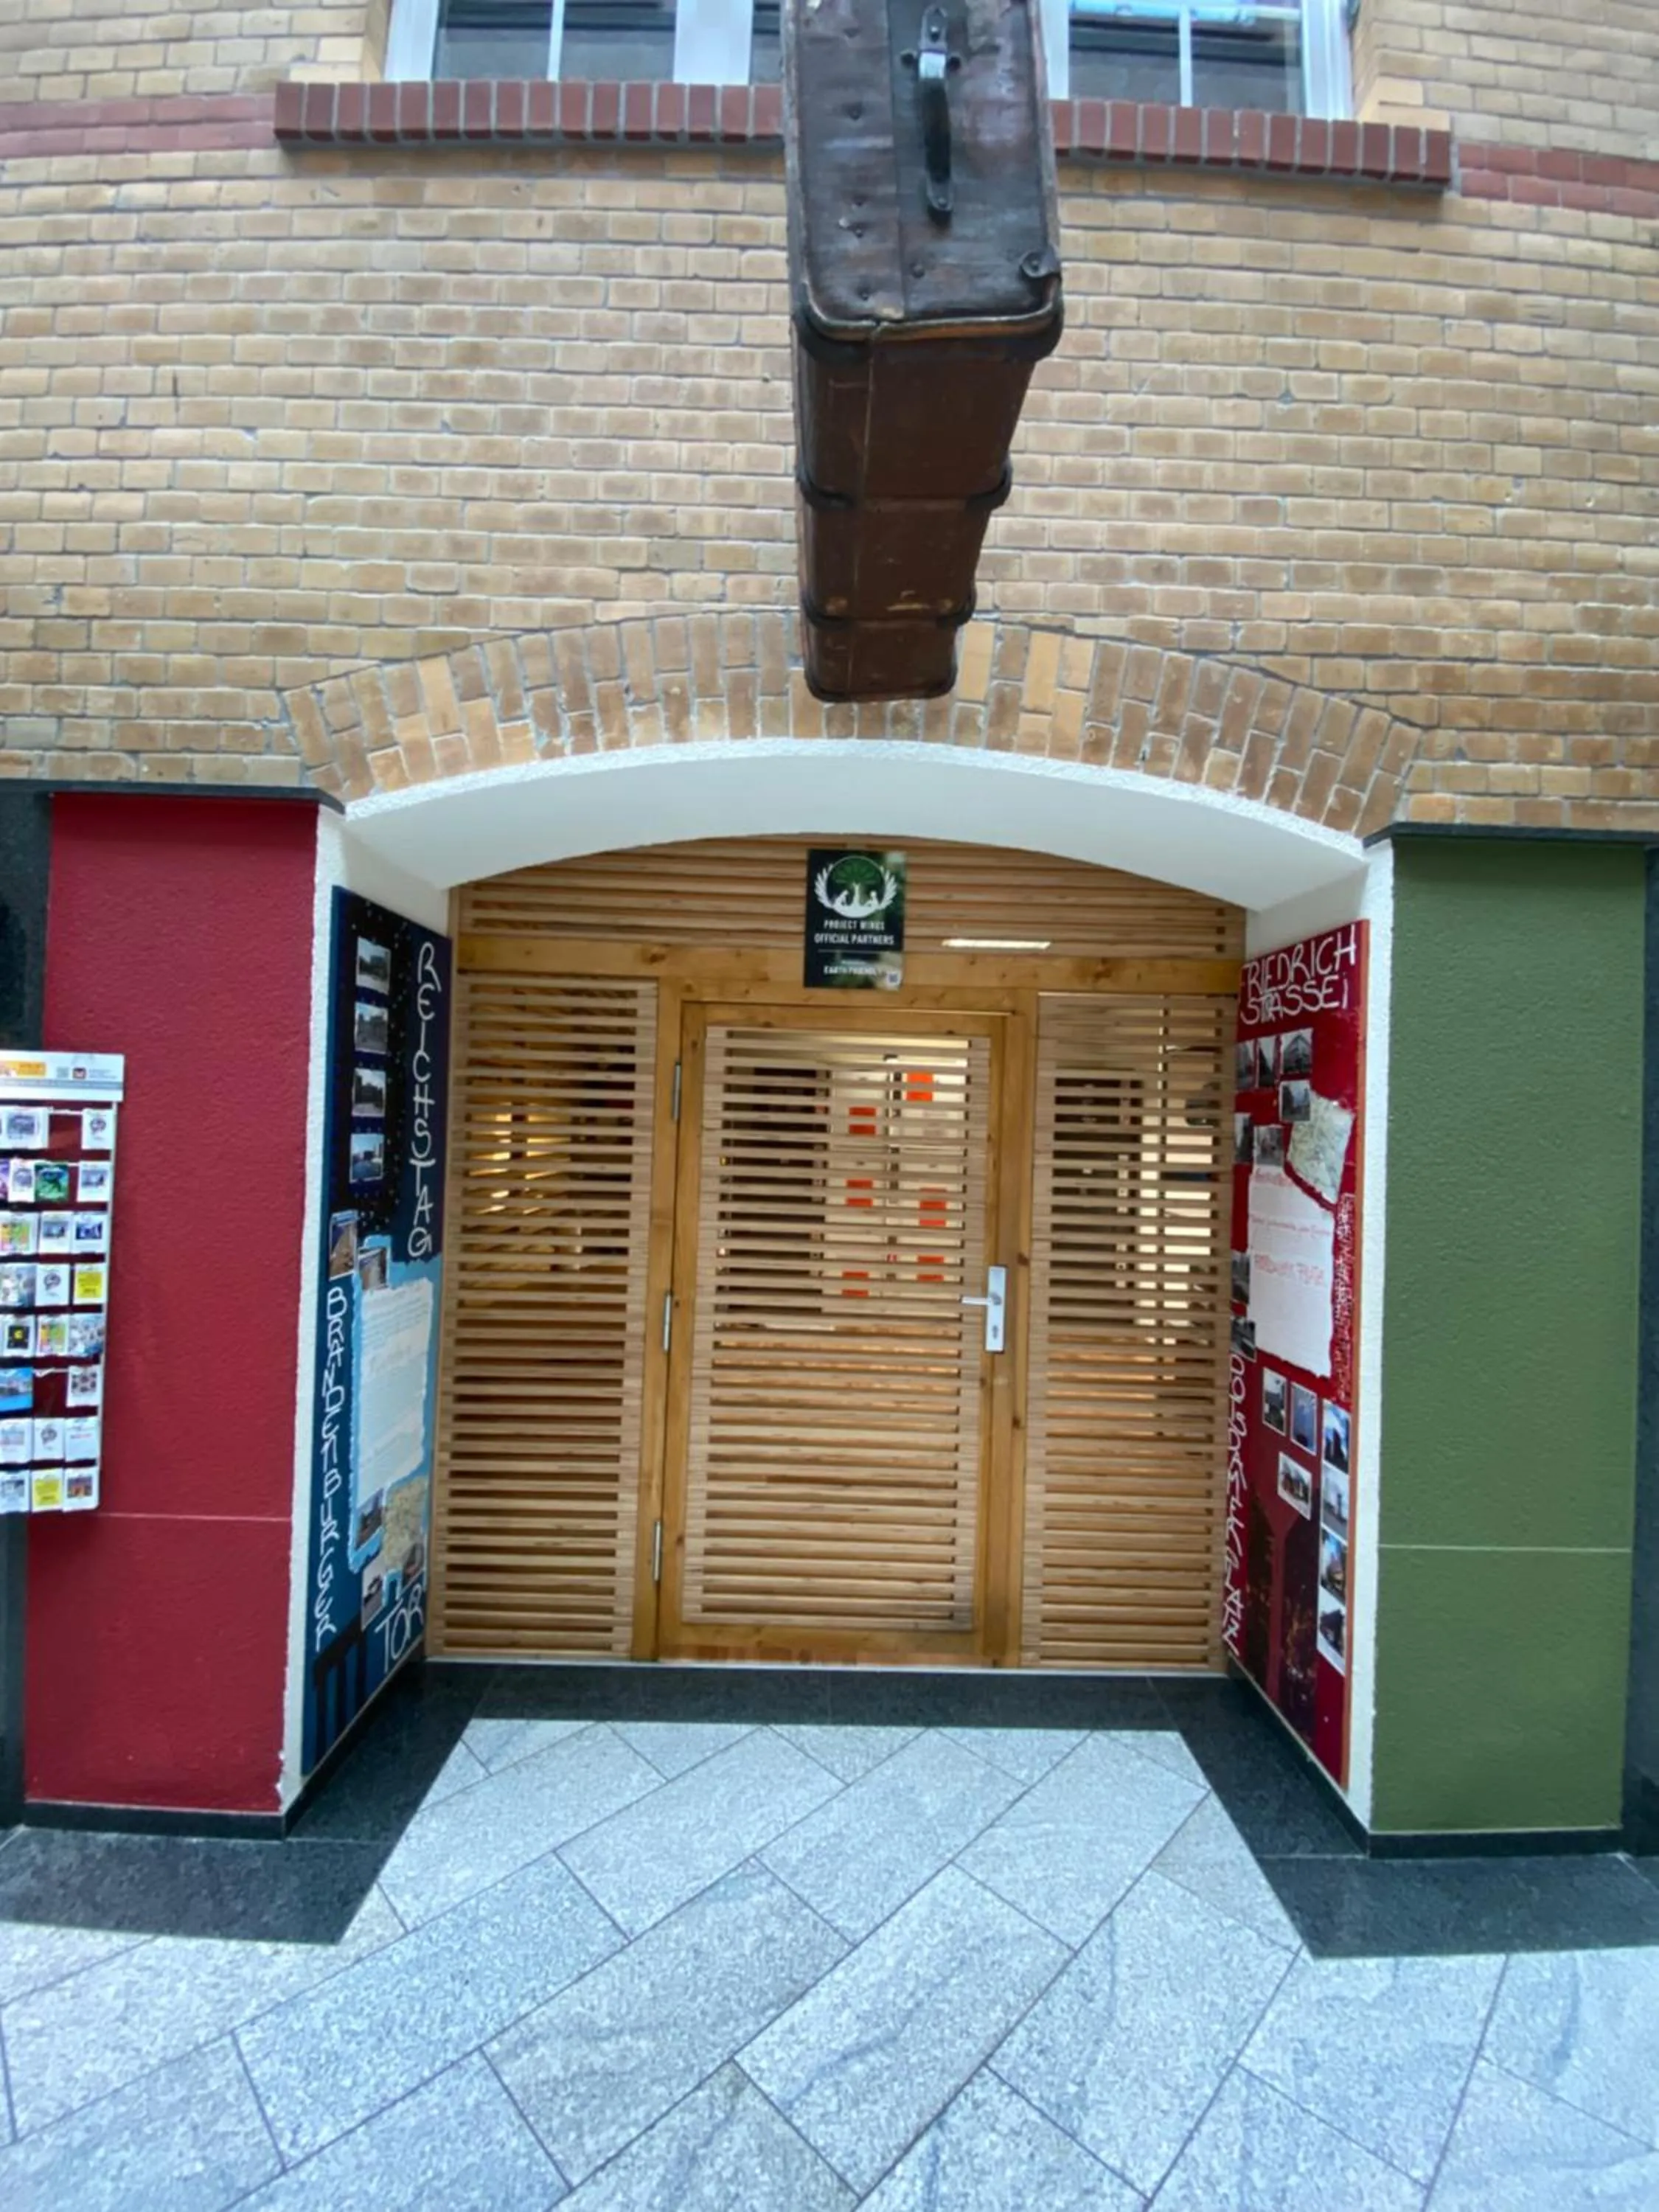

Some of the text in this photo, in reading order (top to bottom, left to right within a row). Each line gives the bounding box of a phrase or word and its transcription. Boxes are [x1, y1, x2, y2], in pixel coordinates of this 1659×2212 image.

[814, 933, 894, 945] OFFICIAL PARTNERS
[824, 919, 857, 929] PROJECT
[408, 942, 441, 1258] REICHSTAG
[314, 1286, 347, 1652] BRANDENBURGER
[374, 1583, 424, 1674] TOR
